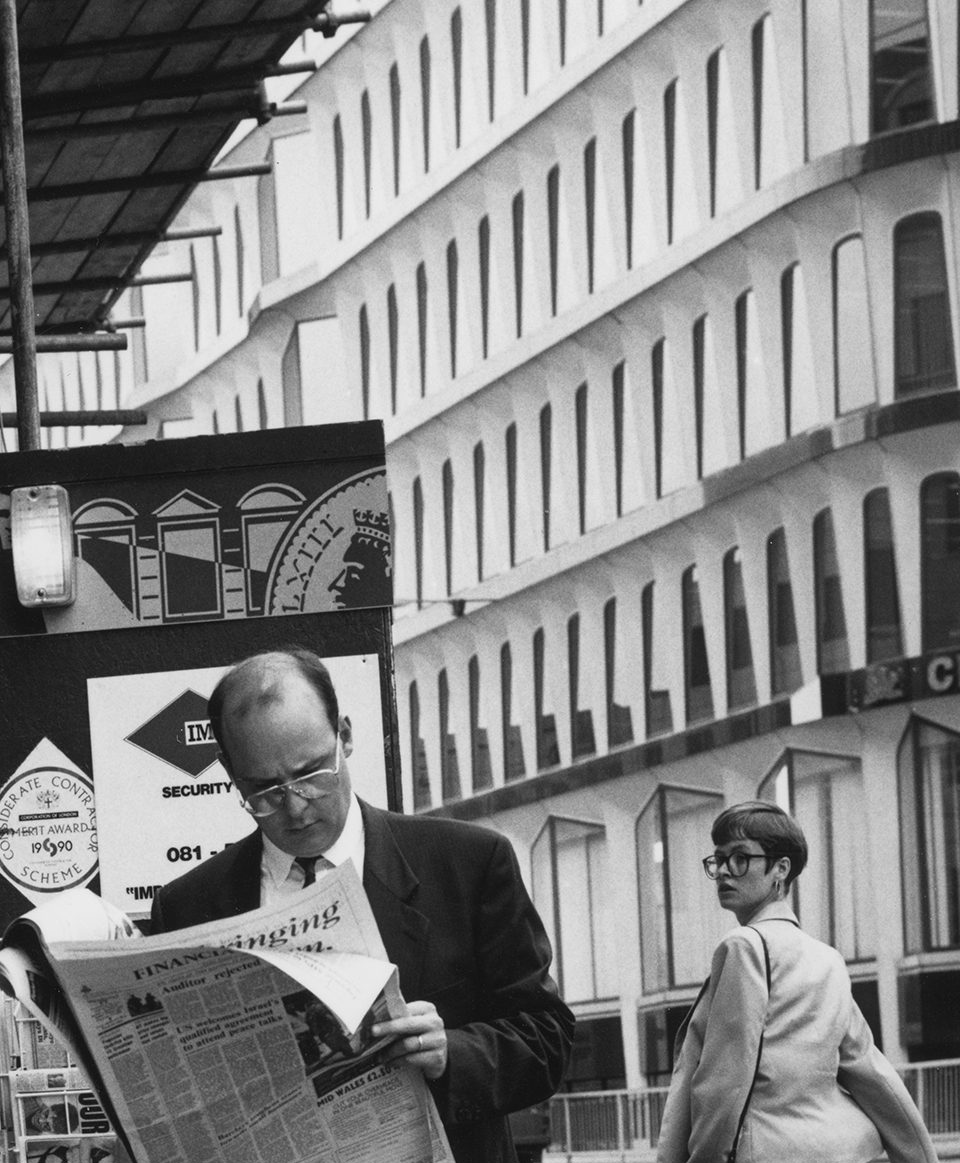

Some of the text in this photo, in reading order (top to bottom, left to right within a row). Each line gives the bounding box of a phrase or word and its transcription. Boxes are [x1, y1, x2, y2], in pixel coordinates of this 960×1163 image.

[162, 781, 232, 799] SECURITY
[14, 822, 88, 837] MERIT AWARD
[167, 845, 203, 862] 081
[21, 863, 83, 884] SCHEME
[162, 958, 261, 996] Auditor rejected
[179, 1023, 222, 1045] qualified
[223, 1010, 275, 1031] agreement
[195, 1011, 238, 1030] welcomes
[197, 1033, 227, 1047] attend
[229, 1026, 257, 1043] peace
[259, 1014, 283, 1030] talks
[316, 1094, 335, 1108] MID
[335, 1079, 366, 1097] WALES
